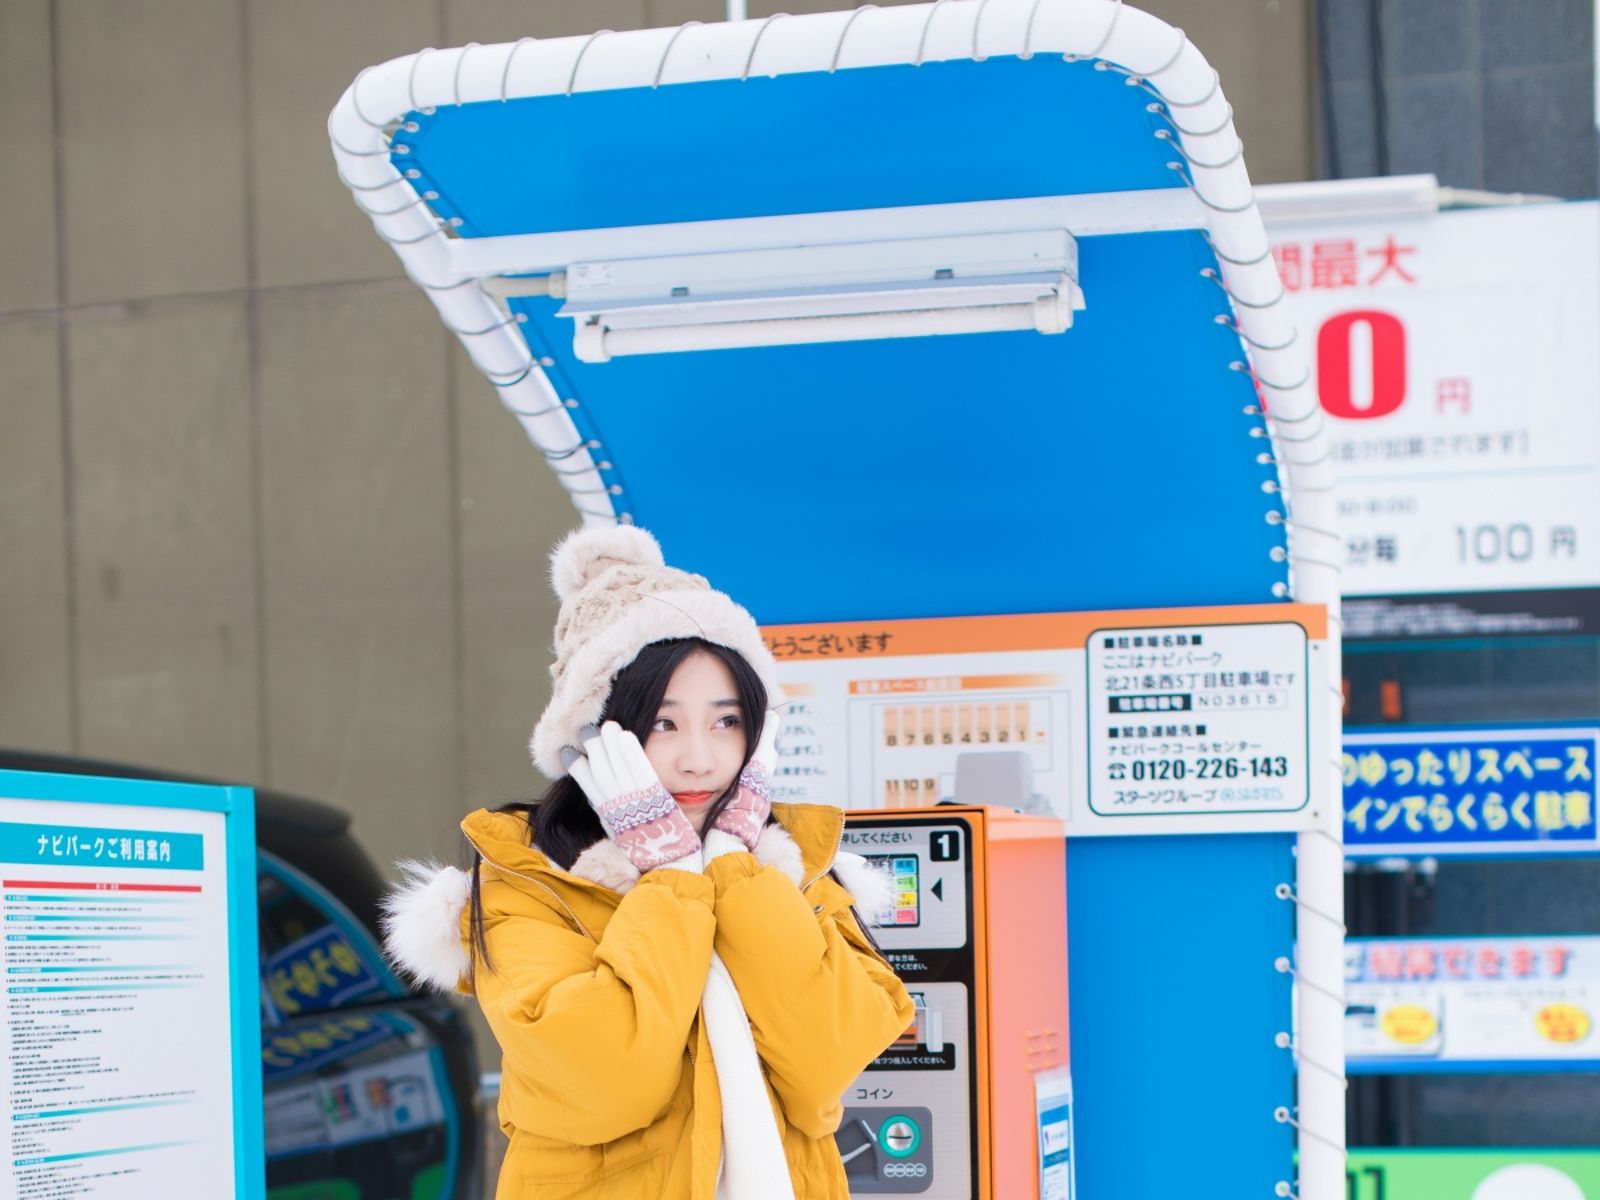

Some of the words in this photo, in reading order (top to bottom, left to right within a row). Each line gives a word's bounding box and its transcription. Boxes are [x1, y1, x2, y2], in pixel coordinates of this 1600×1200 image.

[1455, 523, 1534, 563] 100
[1551, 525, 1578, 560] 円
[762, 632, 893, 656] とうございます
[1132, 756, 1288, 781] 0120-226-143
[937, 834, 950, 858] 1
[857, 1088, 893, 1100] コイン
